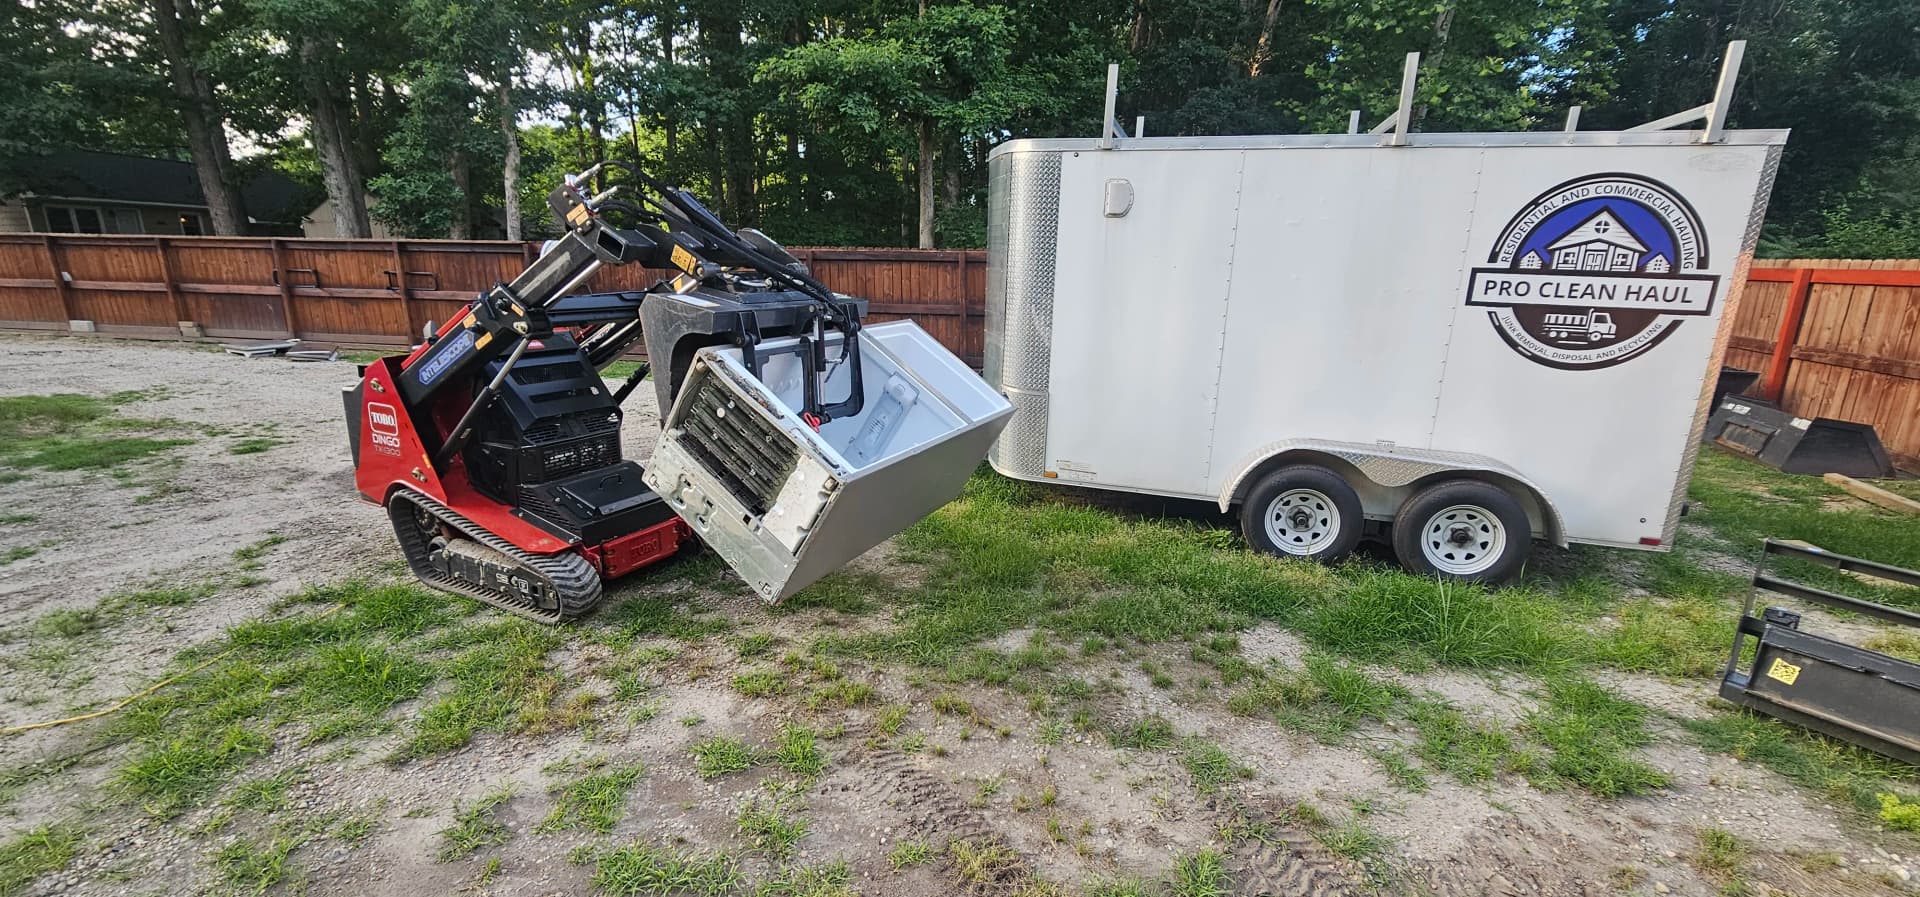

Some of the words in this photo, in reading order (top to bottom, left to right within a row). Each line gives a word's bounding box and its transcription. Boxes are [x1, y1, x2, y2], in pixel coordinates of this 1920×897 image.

[1501, 201, 1559, 262] RESIDENTIAL
[1561, 188, 1590, 204] AND
[1595, 185, 1673, 218] COMMERCIAL
[1672, 216, 1695, 269] HAULING
[1484, 280, 1530, 296] PRO
[1539, 282, 1616, 300] CLEAN
[1624, 285, 1693, 303] HAUL
[1502, 315, 1516, 334] JUNK
[1552, 352, 1593, 361] DISPOSAL
[1596, 350, 1616, 360] AND
[1618, 323, 1662, 353] RECYCLING
[372, 433, 400, 447] DINGO
